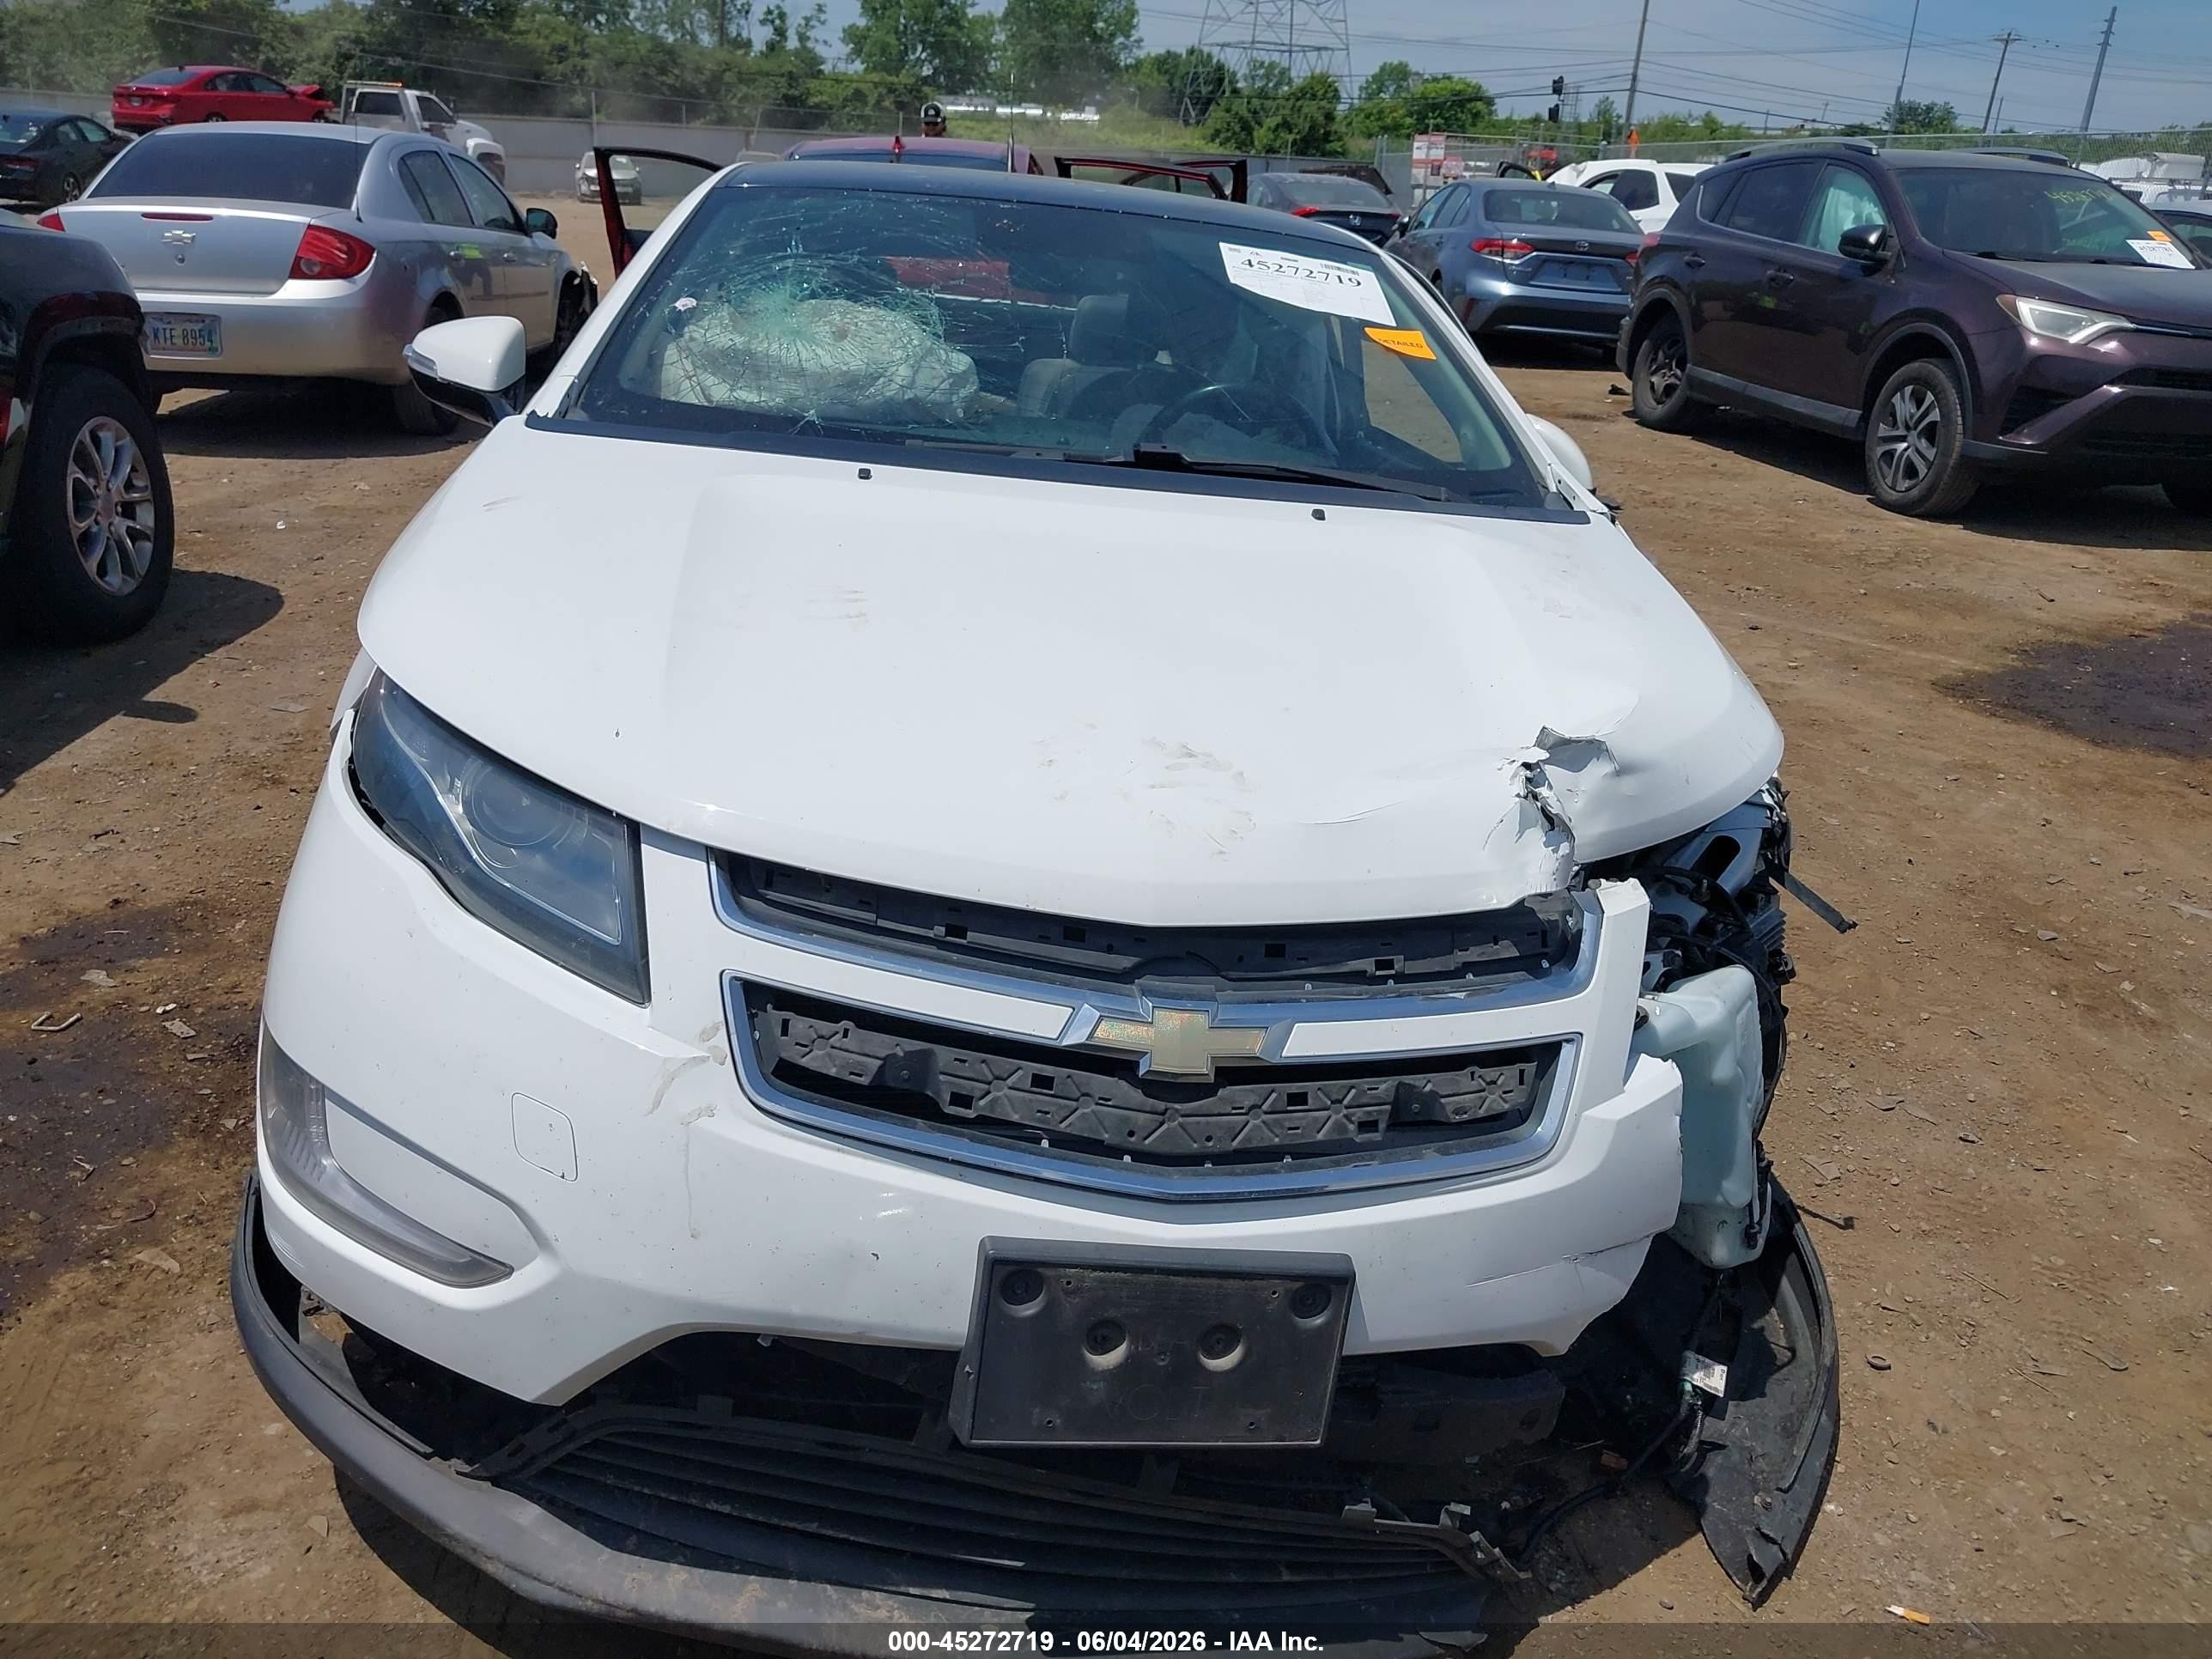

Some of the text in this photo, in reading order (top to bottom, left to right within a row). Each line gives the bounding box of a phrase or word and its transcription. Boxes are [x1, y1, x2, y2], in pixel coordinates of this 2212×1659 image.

[1241, 258, 1362, 288] 45272719
[152, 327, 214, 348] KTE 8954
